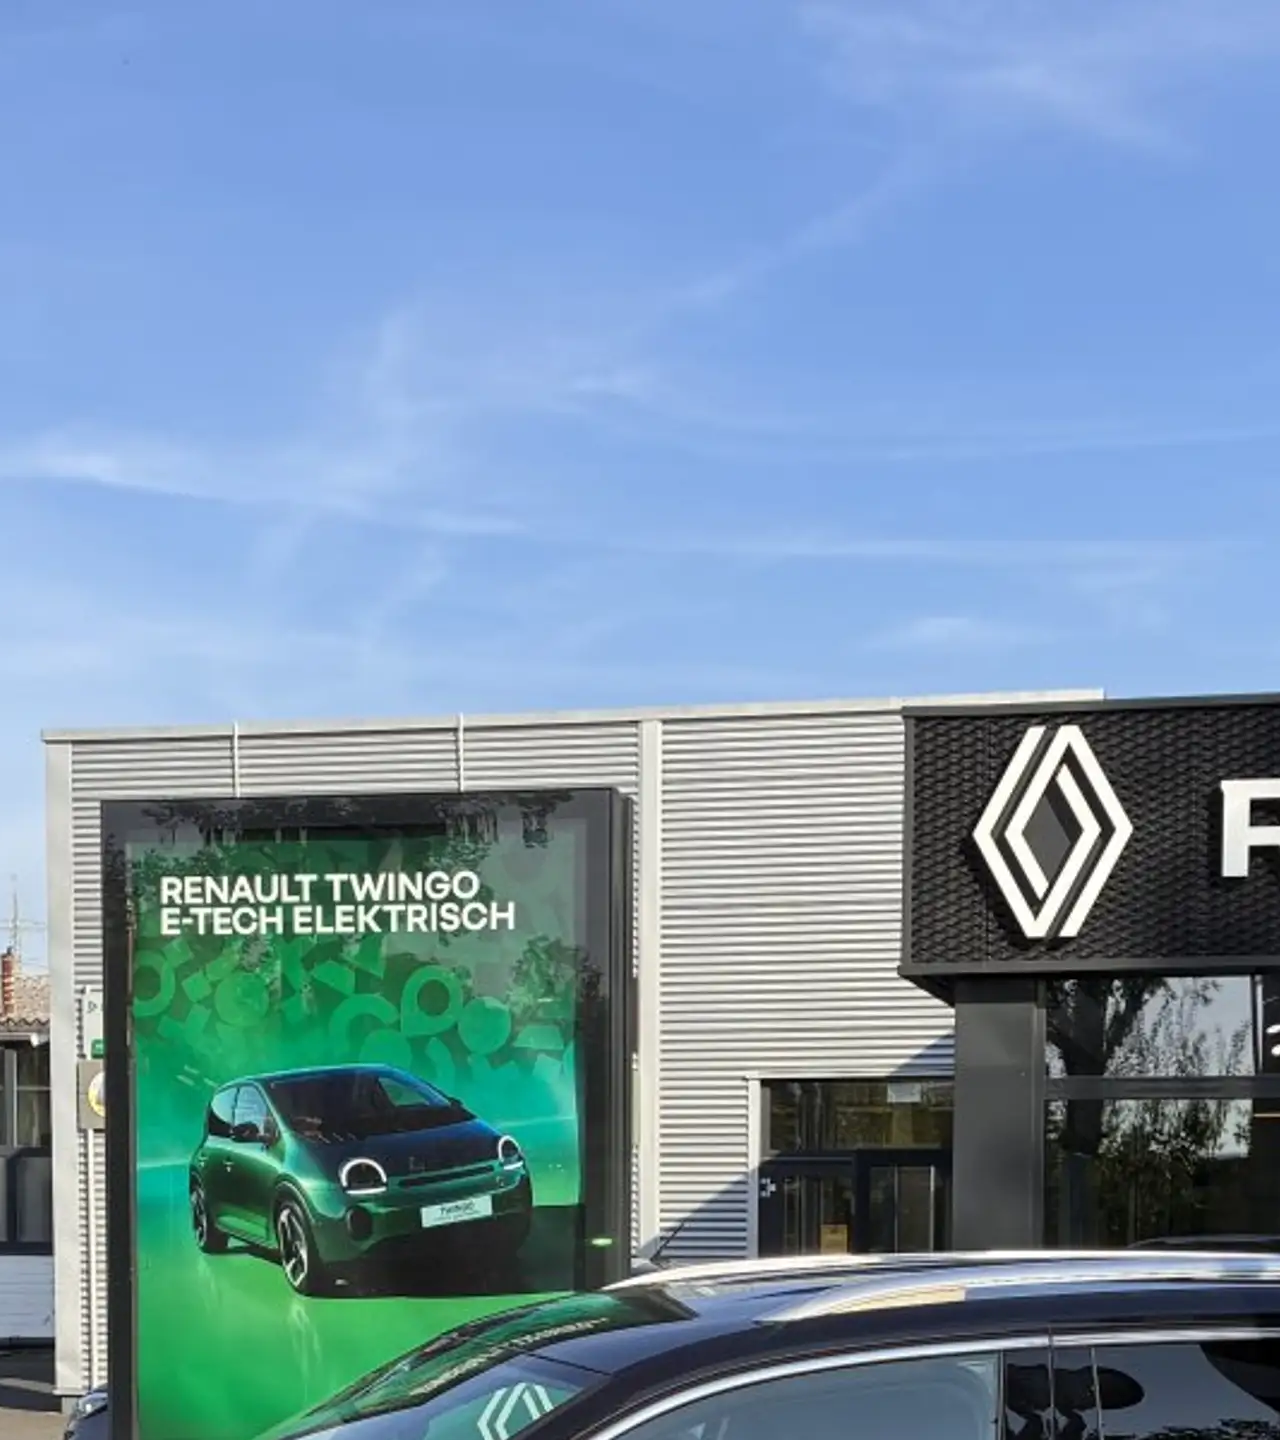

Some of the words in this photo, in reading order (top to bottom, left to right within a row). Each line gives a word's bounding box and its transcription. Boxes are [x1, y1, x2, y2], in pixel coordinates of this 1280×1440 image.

[160, 874, 318, 905] RENAULT
[324, 870, 480, 902] TWINGO
[160, 905, 284, 936] E-TECH
[292, 901, 516, 933] ELEKTRISCH
